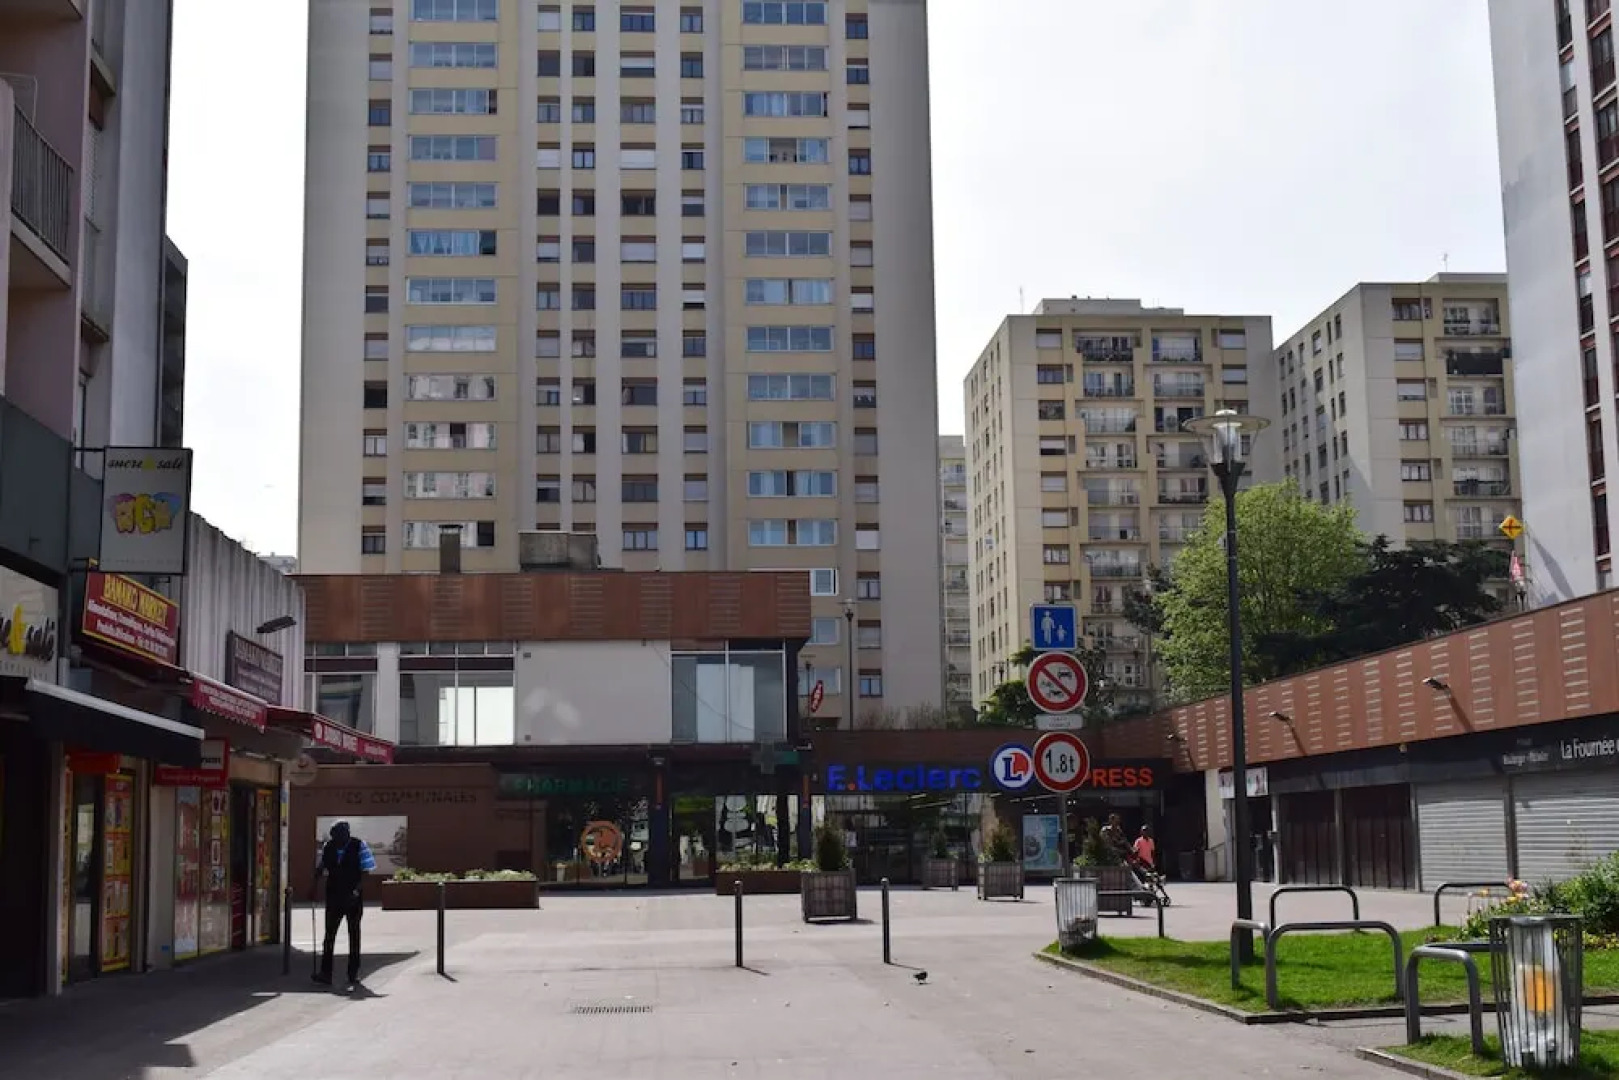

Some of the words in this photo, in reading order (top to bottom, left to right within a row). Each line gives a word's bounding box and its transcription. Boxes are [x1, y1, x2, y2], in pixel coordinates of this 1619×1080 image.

[1561, 740, 1573, 759] La
[1046, 749, 1075, 774] 1.8t
[514, 776, 629, 793] PHARMACIE
[827, 764, 982, 791] E.Leclerc
[371, 790, 477, 804] COMMUNALES
